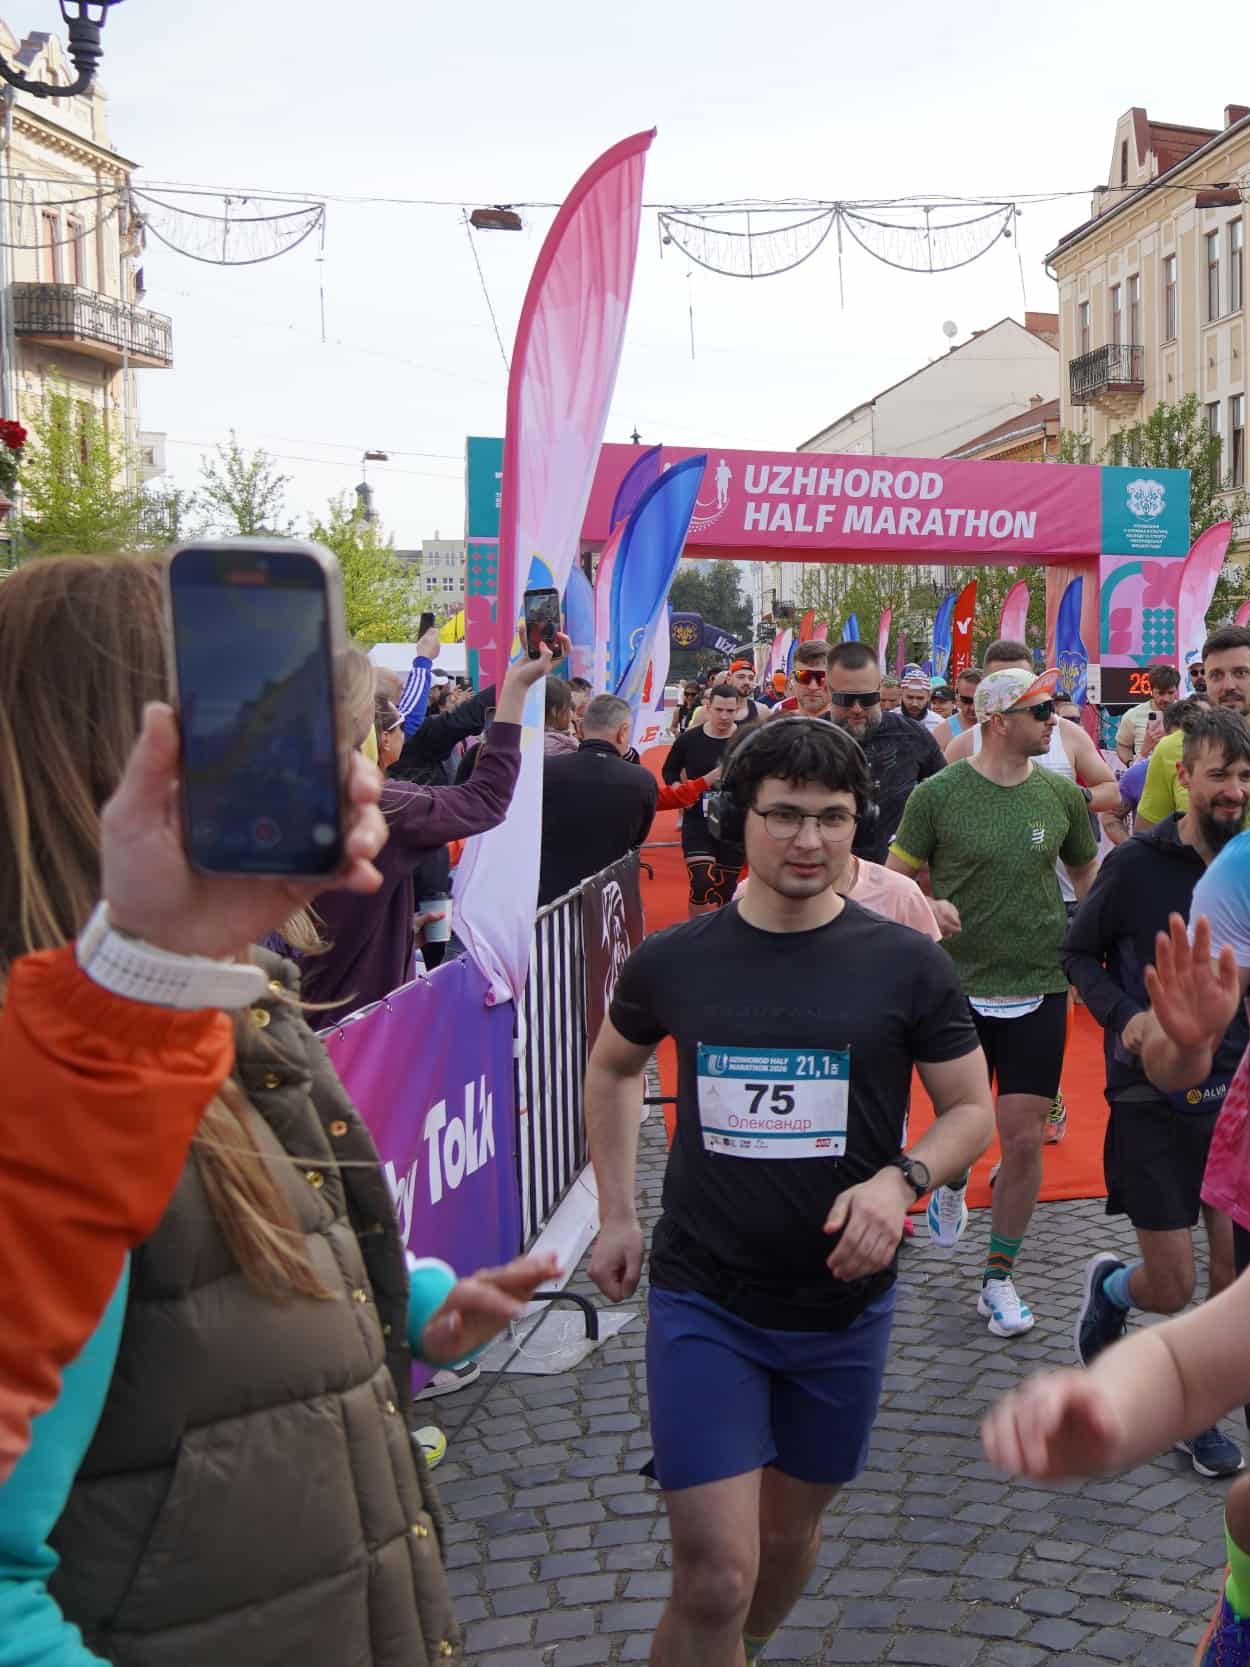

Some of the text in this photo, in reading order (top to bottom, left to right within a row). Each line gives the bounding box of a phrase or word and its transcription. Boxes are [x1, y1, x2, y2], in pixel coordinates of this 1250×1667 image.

[744, 464, 944, 499] UZHHOROD
[744, 501, 1037, 538] HALF MARATHON
[796, 1056, 830, 1078] 21,1
[744, 1084, 796, 1115] 75
[728, 1115, 812, 1133] Олександр
